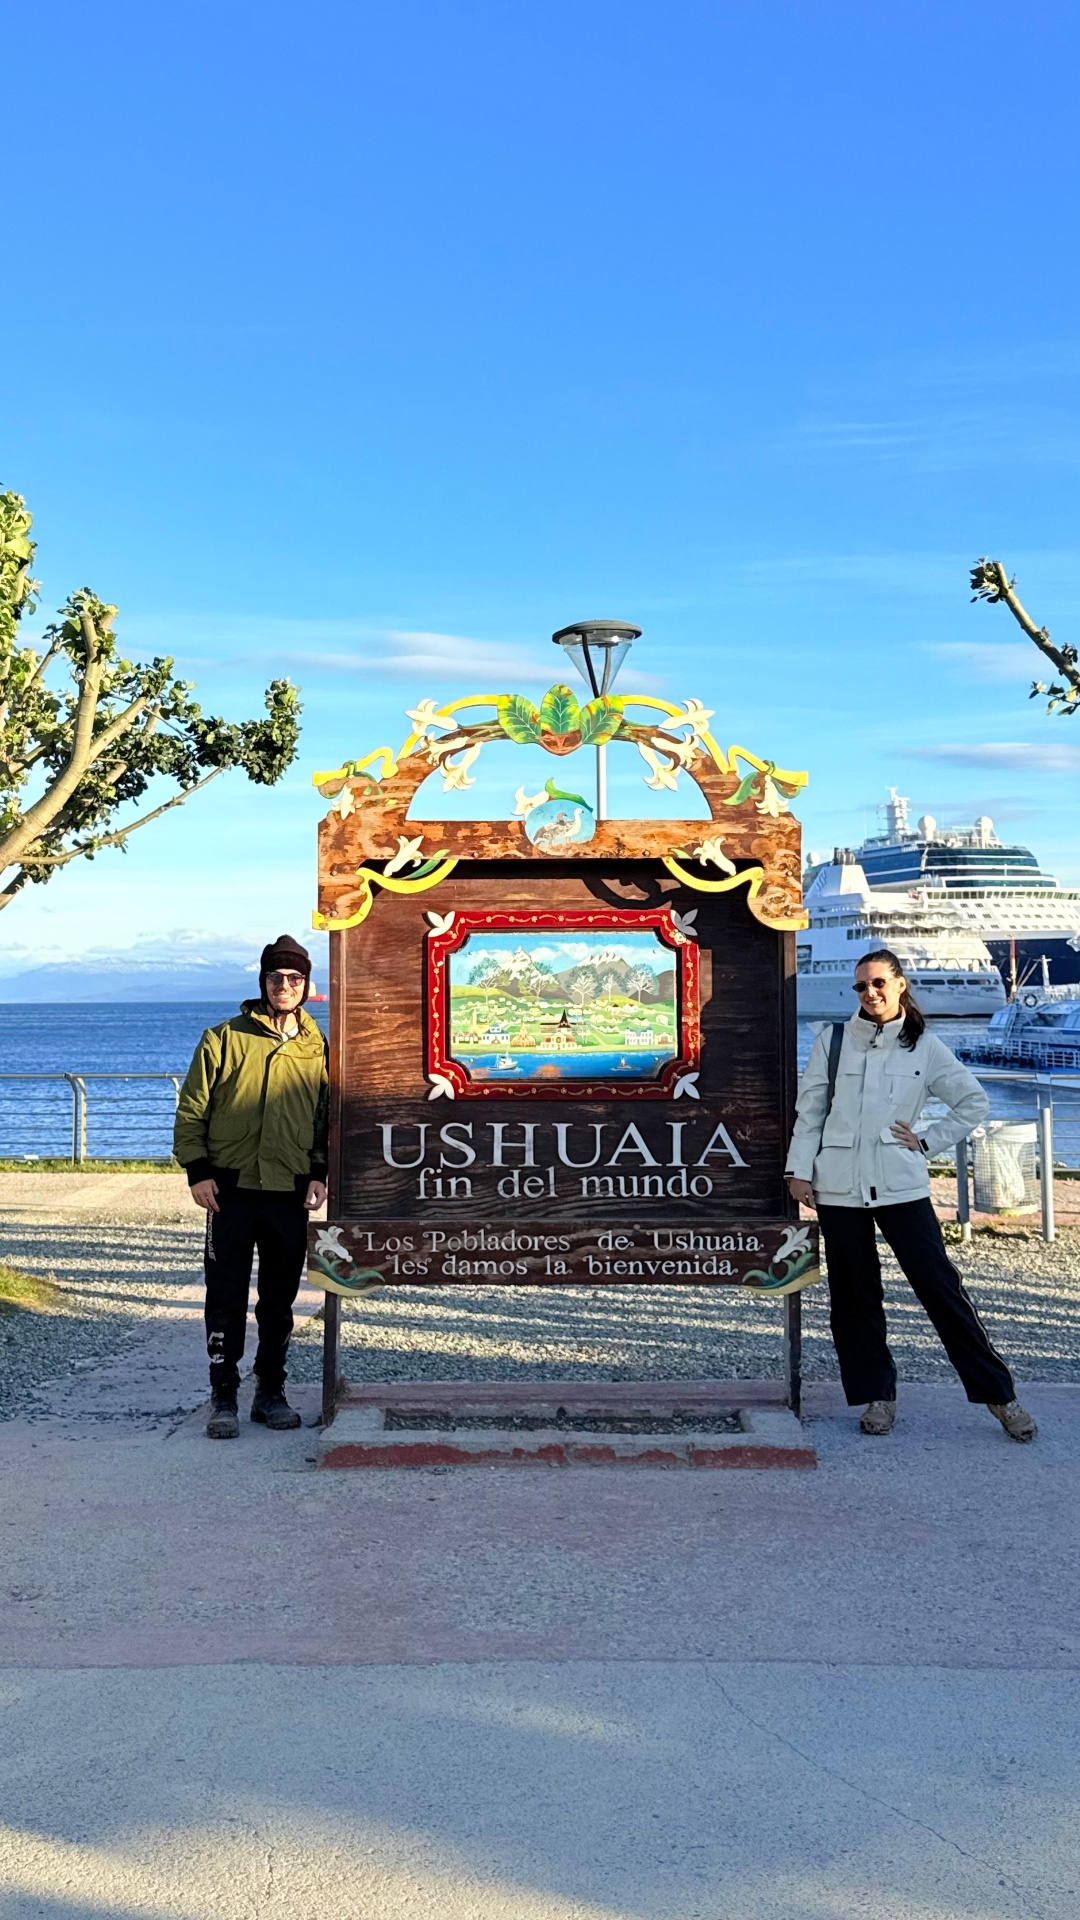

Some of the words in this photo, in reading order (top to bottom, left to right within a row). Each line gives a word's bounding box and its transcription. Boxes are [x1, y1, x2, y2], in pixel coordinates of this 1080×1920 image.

[375, 1121, 752, 1169] USHUAIA
[416, 1167, 475, 1200] fin
[497, 1166, 559, 1199] del
[578, 1168, 713, 1198] mundo
[359, 1231, 414, 1252] Los
[422, 1228, 571, 1253] Pobladores
[597, 1230, 635, 1252] de
[646, 1230, 765, 1252] Ushuaia
[385, 1254, 432, 1276] les
[441, 1253, 528, 1276] damos
[544, 1254, 573, 1276] la
[582, 1254, 739, 1276] bienvenida
